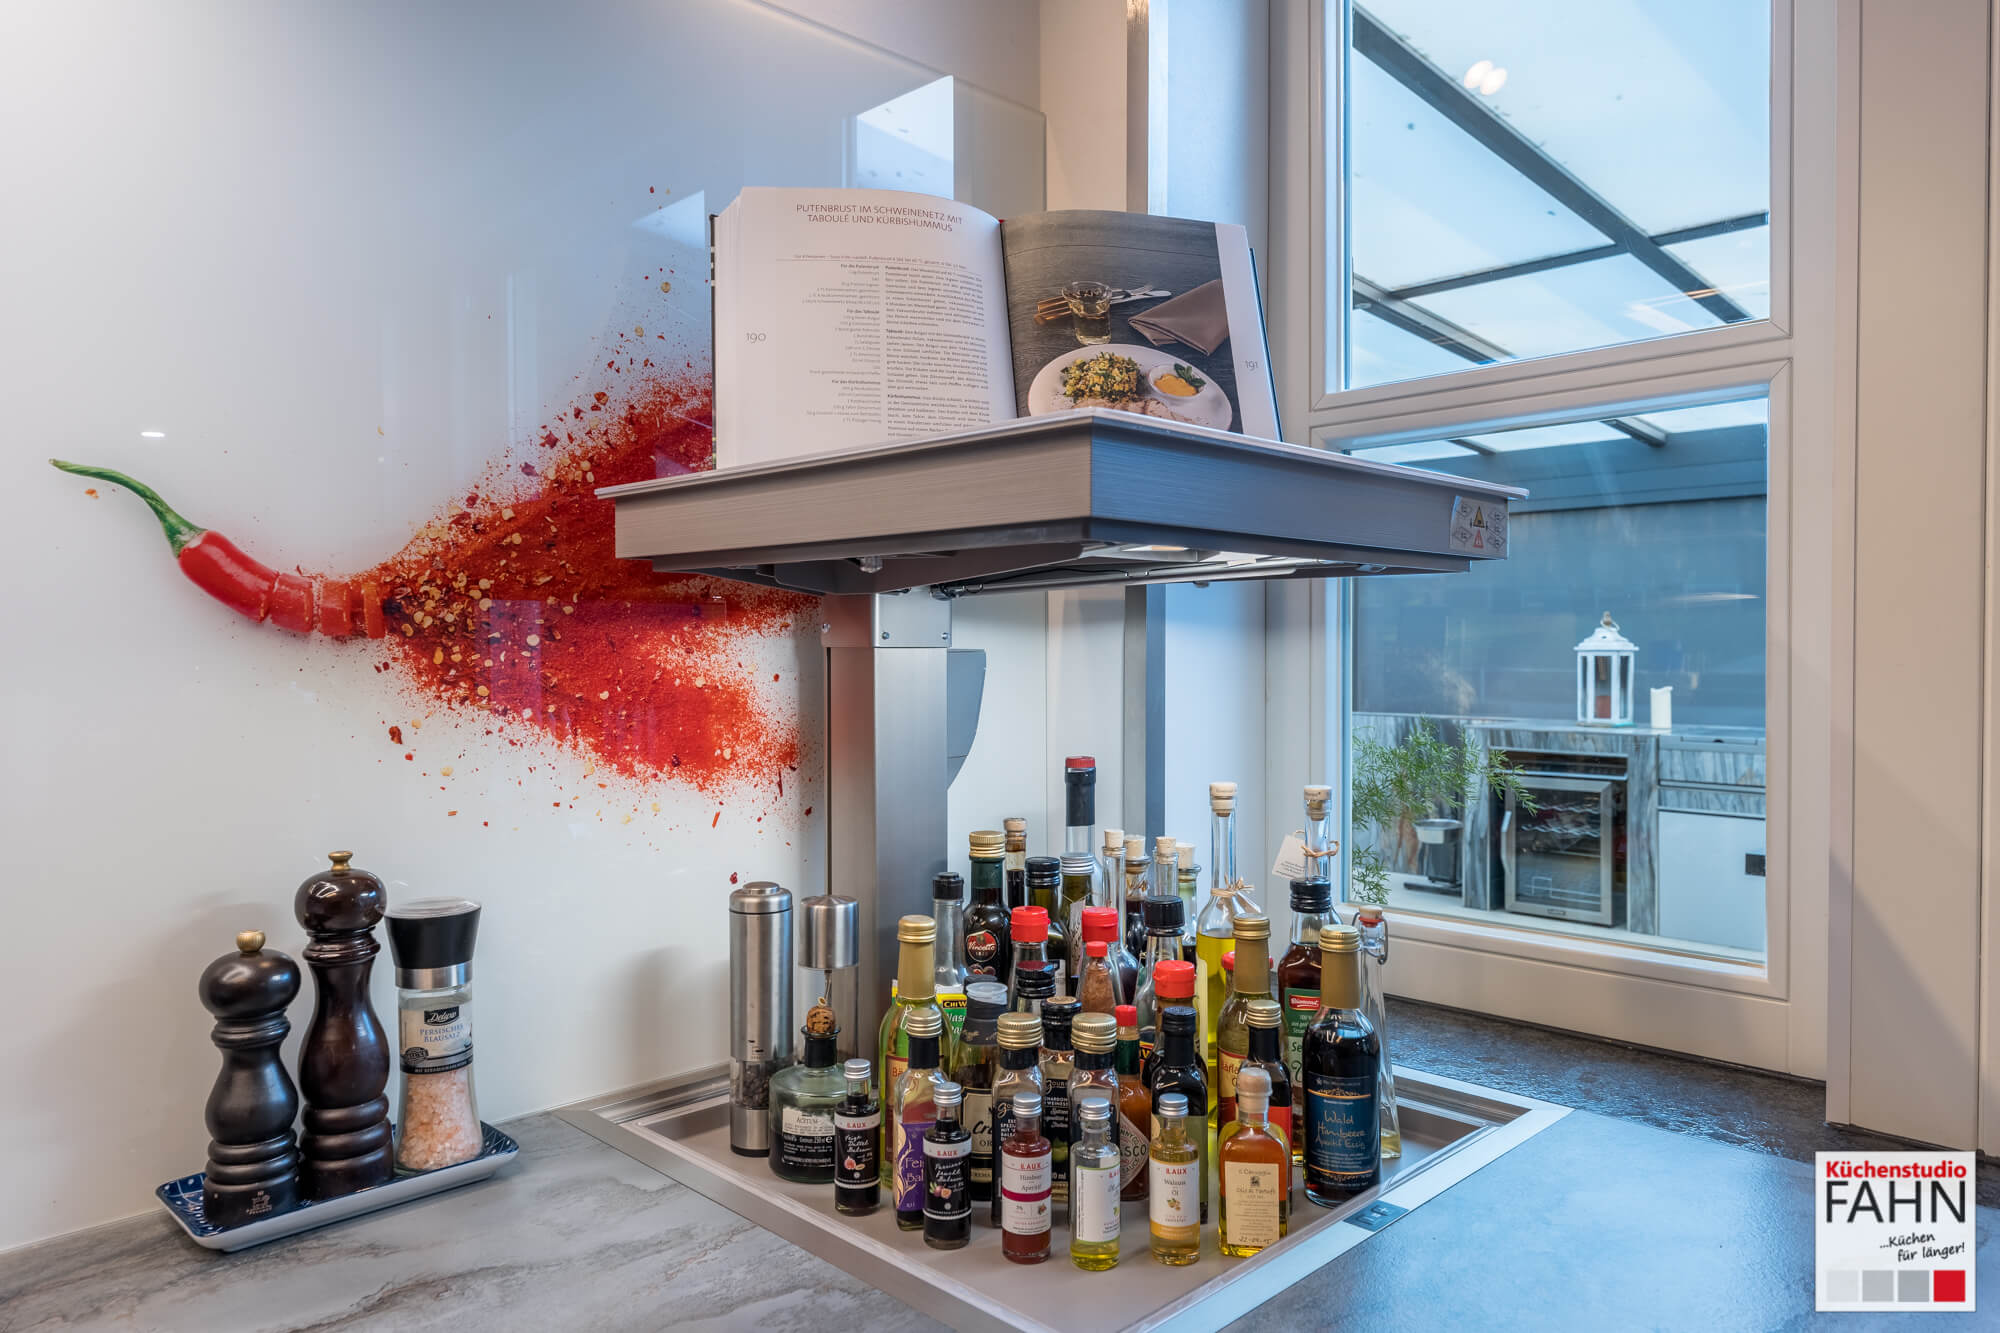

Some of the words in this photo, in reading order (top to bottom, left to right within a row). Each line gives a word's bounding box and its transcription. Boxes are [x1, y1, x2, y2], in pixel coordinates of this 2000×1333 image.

[796, 203, 857, 214] PUTENBRUST
[859, 205, 872, 214] IM
[874, 206, 945, 220] SCHWEINENETZ
[946, 215, 963, 225] MIT
[852, 215, 874, 224] UND
[876, 216, 953, 232] KÜRBISHUMMUS
[746, 332, 767, 344] 190
